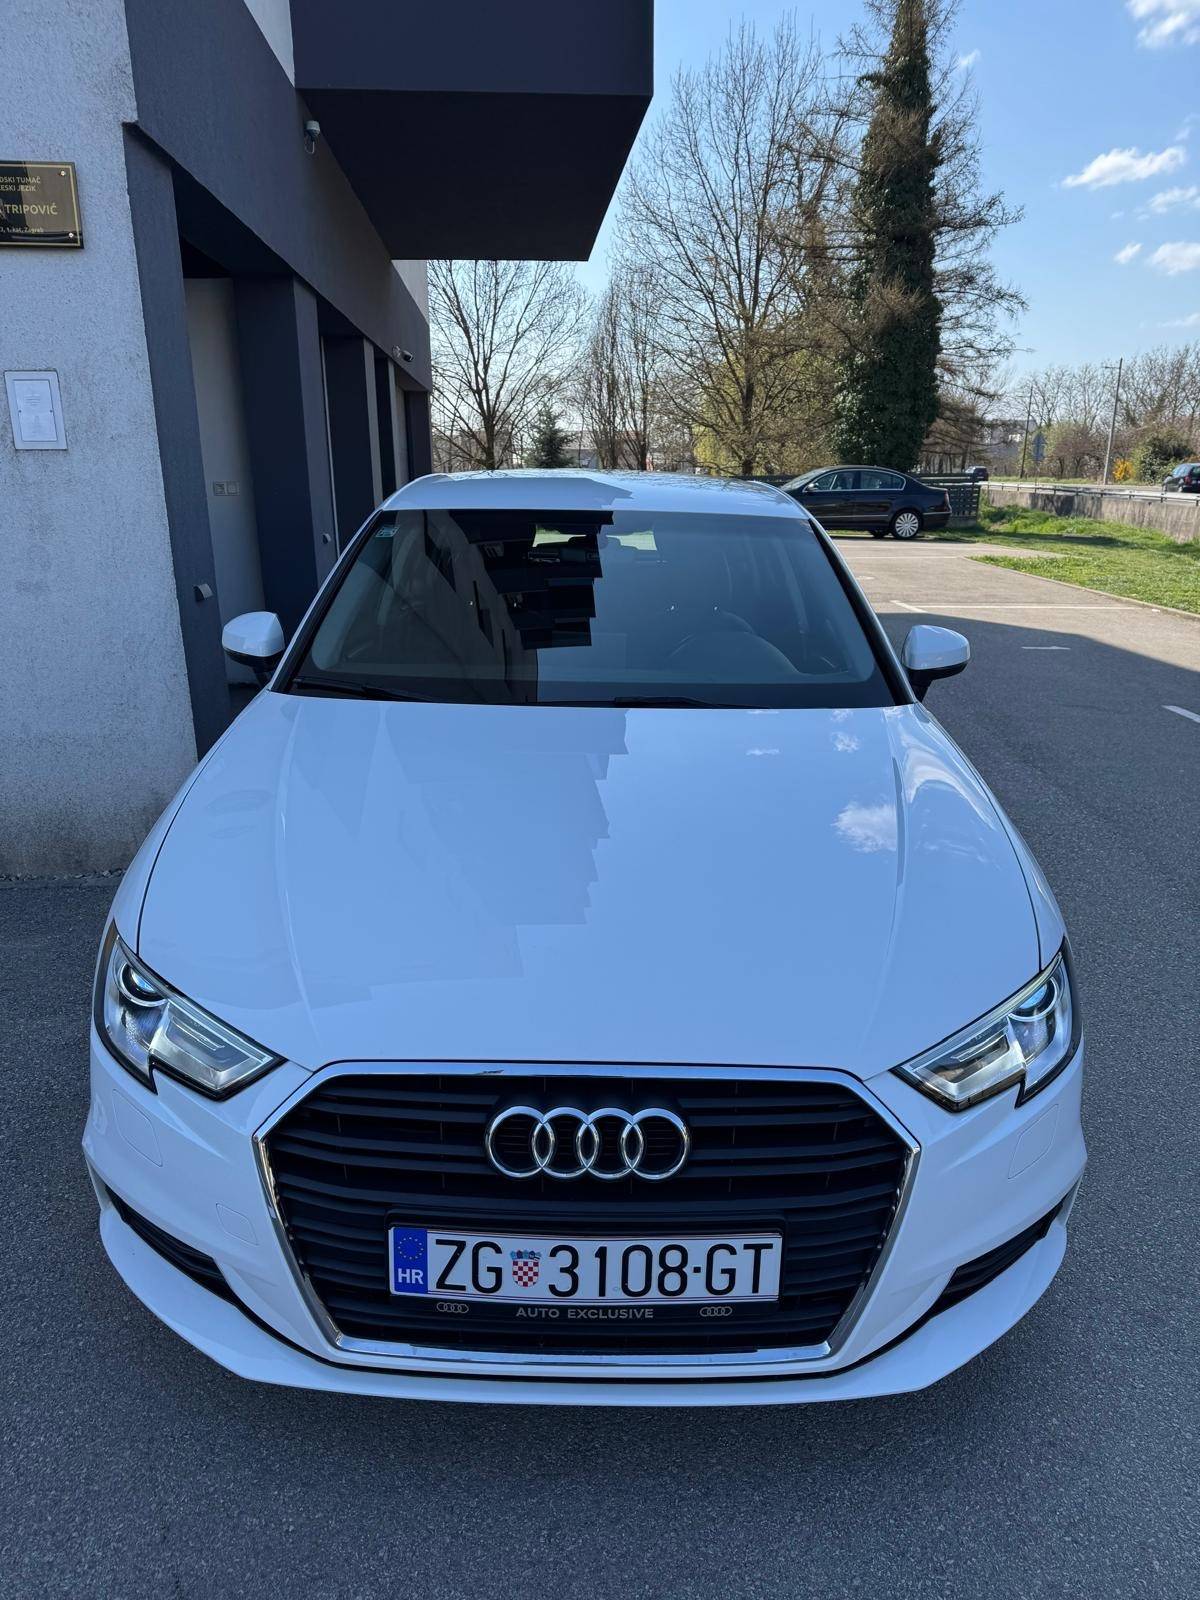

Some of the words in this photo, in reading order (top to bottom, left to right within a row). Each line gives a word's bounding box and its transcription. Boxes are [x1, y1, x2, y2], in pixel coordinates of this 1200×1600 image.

[16, 176, 41, 184] TUMAČ
[4, 202, 58, 215] TRIPOVIĆ
[435, 1238, 503, 1294] ZG
[398, 1268, 424, 1285] HR
[516, 1307, 560, 1319] AUTO
[567, 1308, 654, 1319] EXCLUSIVE
